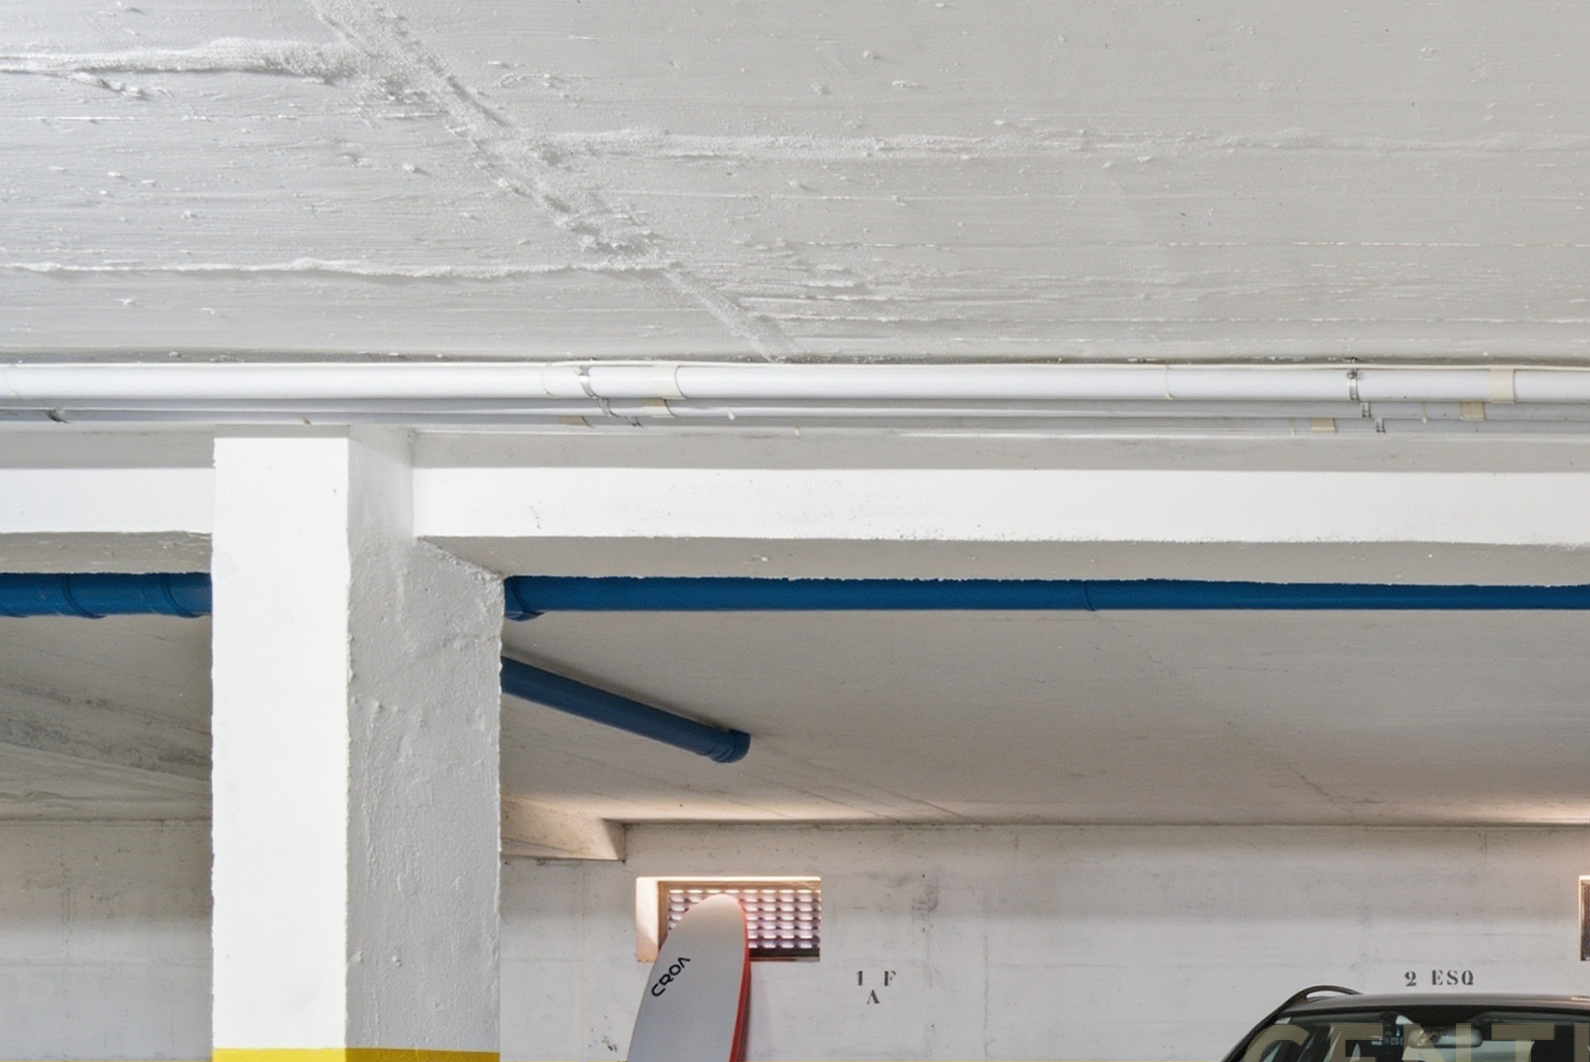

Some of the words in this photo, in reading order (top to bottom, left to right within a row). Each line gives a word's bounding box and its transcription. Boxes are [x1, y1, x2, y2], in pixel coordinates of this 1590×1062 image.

[1404, 970, 1417, 987] 2
[1431, 970, 1474, 986] ESQ
[866, 989, 880, 1005] A
